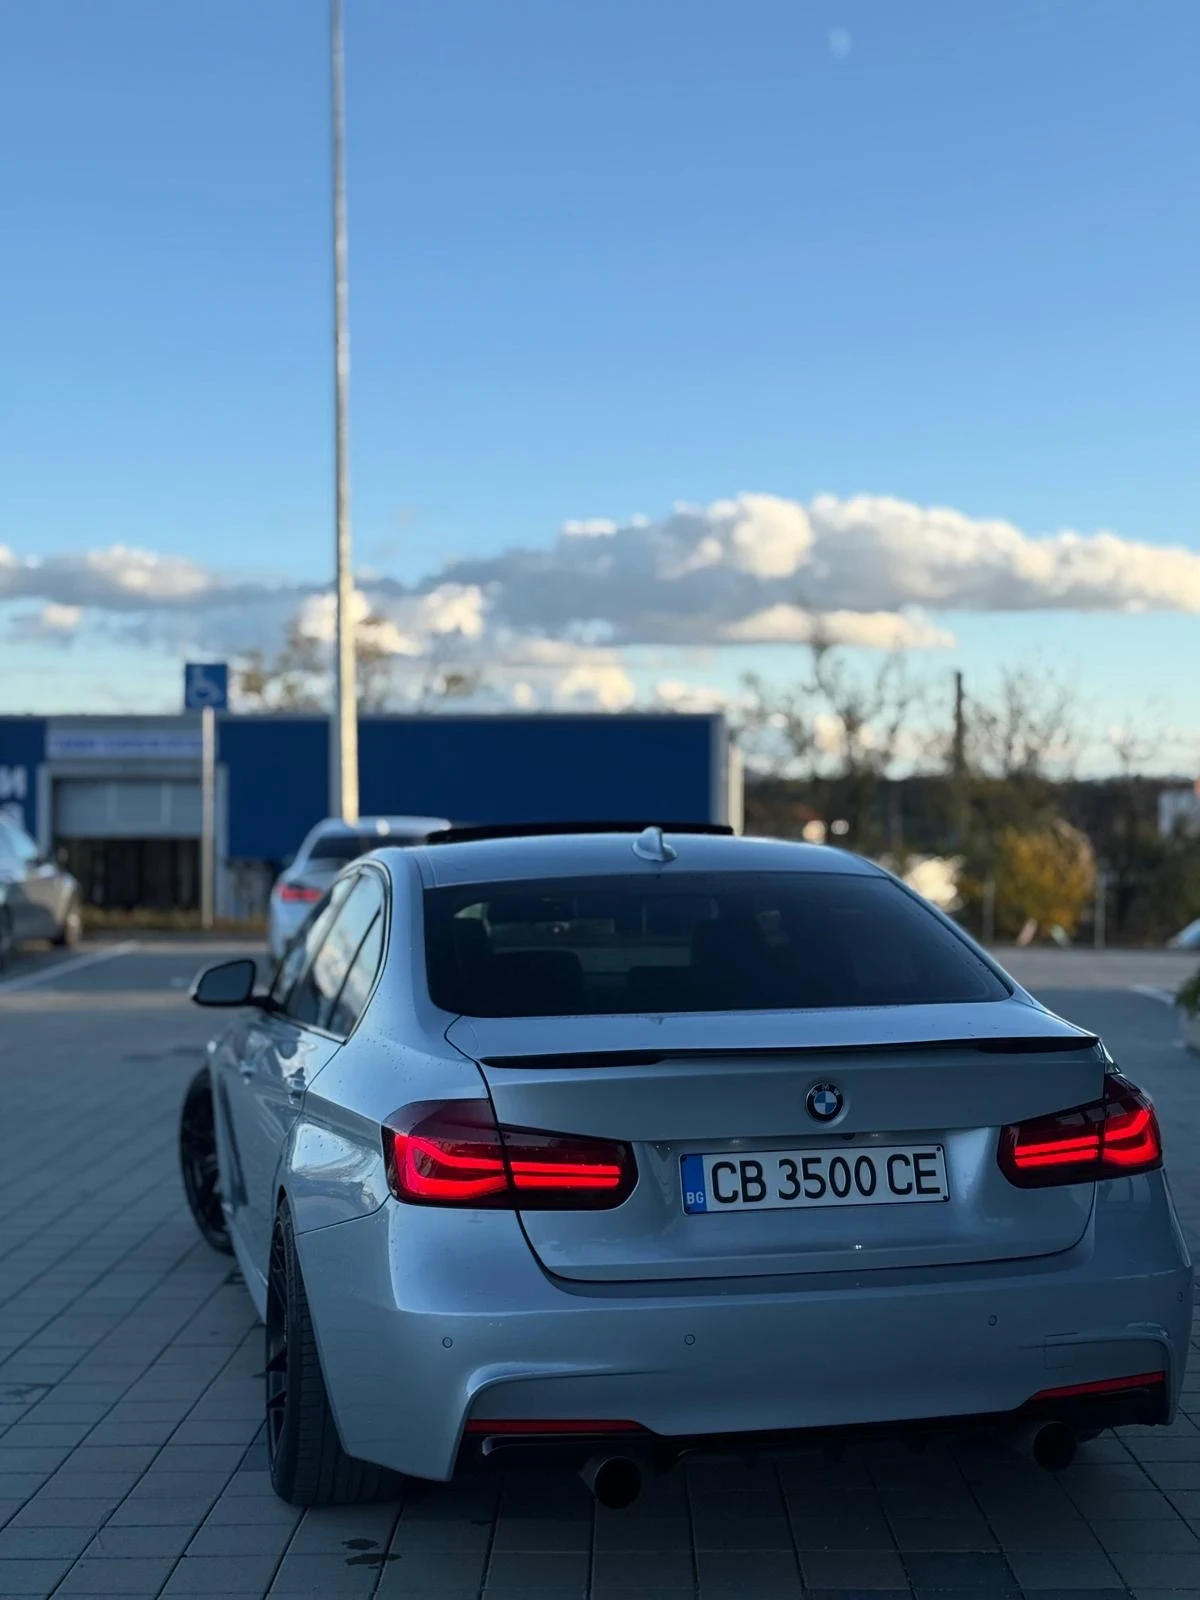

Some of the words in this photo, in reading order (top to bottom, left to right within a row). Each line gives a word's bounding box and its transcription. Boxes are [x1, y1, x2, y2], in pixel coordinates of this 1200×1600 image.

[711, 1160, 766, 1204] CB
[778, 1155, 876, 1200] 3500
[886, 1152, 941, 1195] CE
[686, 1191, 704, 1204] BG
